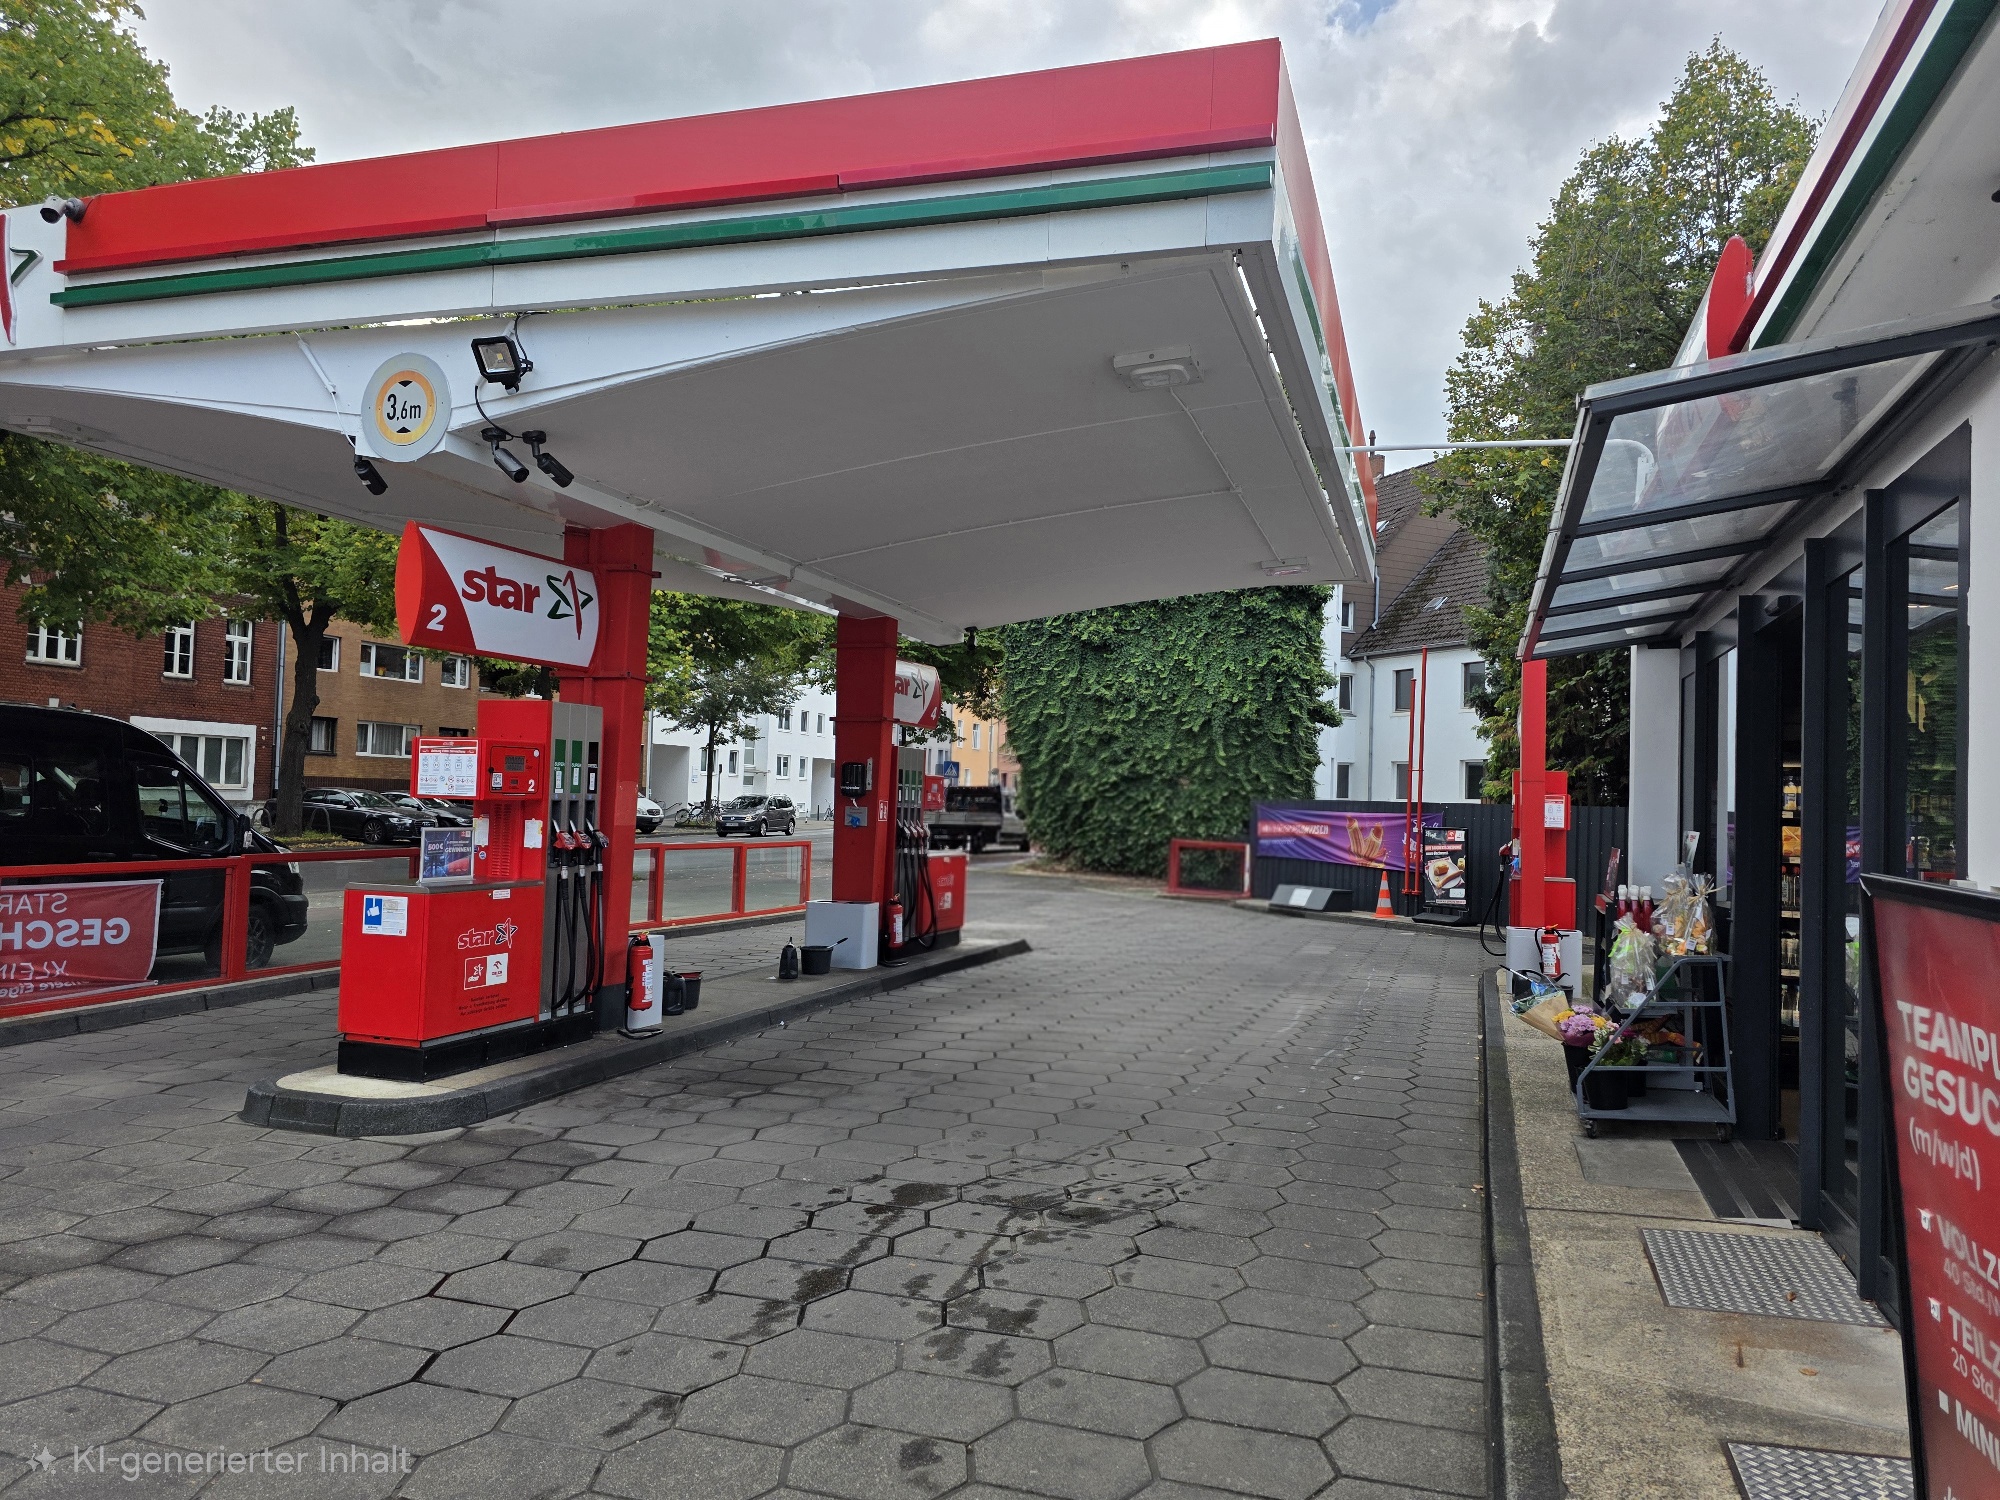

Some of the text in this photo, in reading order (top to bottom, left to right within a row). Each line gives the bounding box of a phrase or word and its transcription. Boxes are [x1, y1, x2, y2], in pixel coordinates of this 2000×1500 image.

[386, 393, 421, 421] 3,6m
[461, 566, 541, 614] star
[426, 603, 448, 632] 2
[894, 675, 911, 697] ar
[930, 706, 938, 721] 4
[527, 779, 535, 792] 2
[457, 928, 494, 950] star
[1903, 1055, 2000, 1137] GESUC
[1943, 1257, 1960, 1286] 40
[1950, 1346, 1968, 1378] 20
